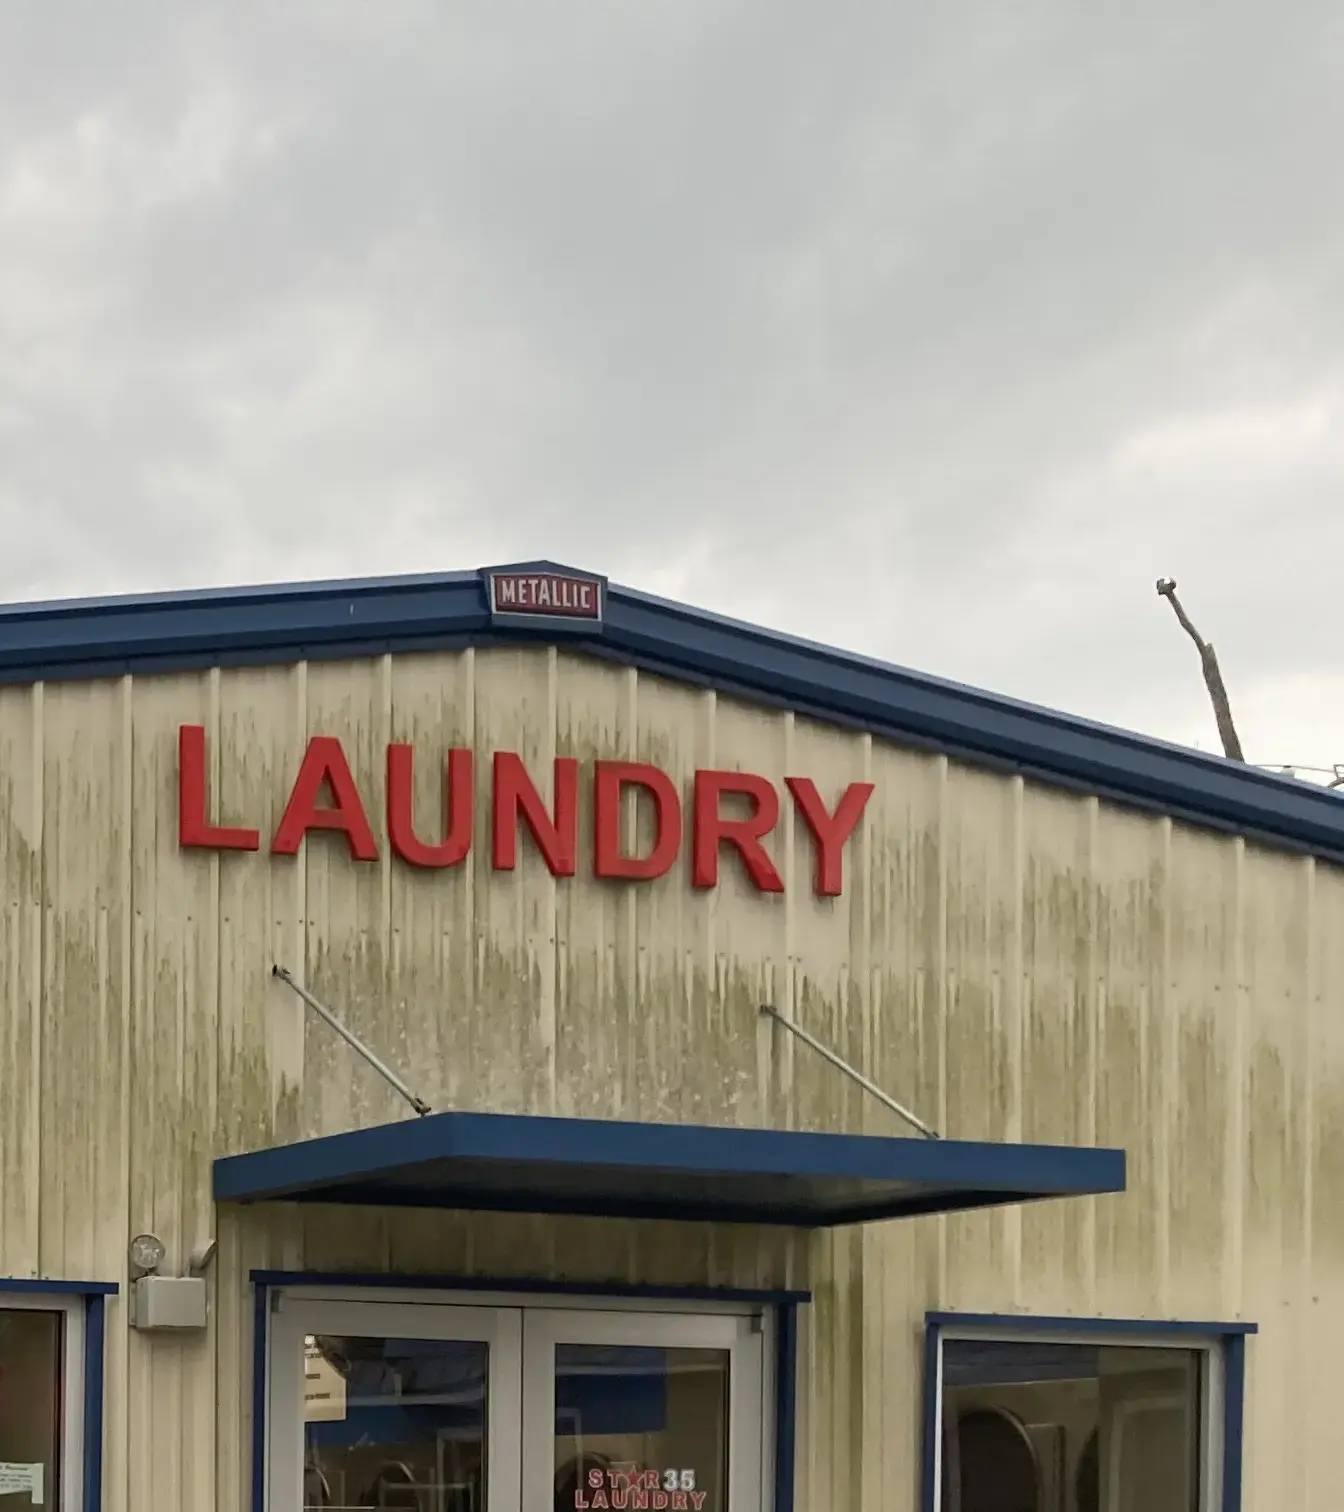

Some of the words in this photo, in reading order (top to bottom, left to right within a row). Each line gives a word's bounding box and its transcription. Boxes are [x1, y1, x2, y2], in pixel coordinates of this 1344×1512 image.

[501, 578, 591, 609] METALLIC
[179, 724, 875, 897] LAUNDRY
[663, 1468, 696, 1492] 35
[574, 1488, 707, 1511] LAUNDRY
